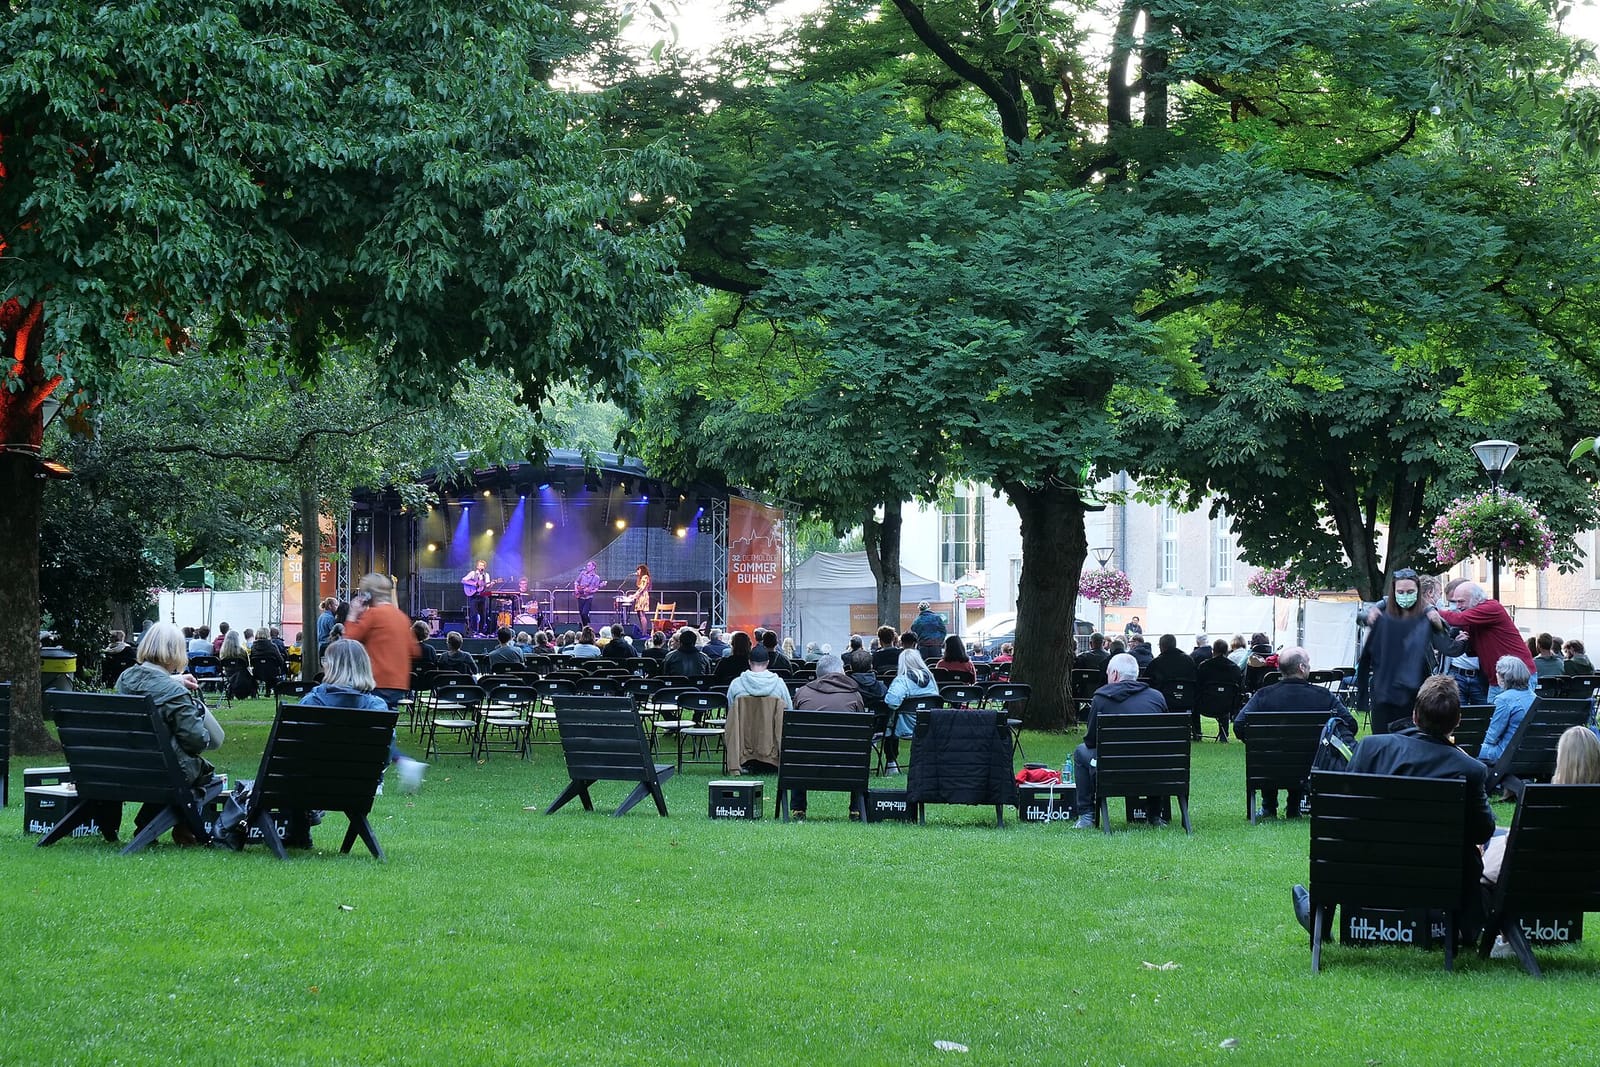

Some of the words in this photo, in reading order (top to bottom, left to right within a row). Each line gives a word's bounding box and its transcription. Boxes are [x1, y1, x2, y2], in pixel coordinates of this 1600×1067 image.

[733, 563, 777, 572] SOMMER
[737, 573, 773, 584] BÜHNE
[1027, 805, 1070, 820] fritz-kola
[1350, 916, 1413, 942] fritz-kola
